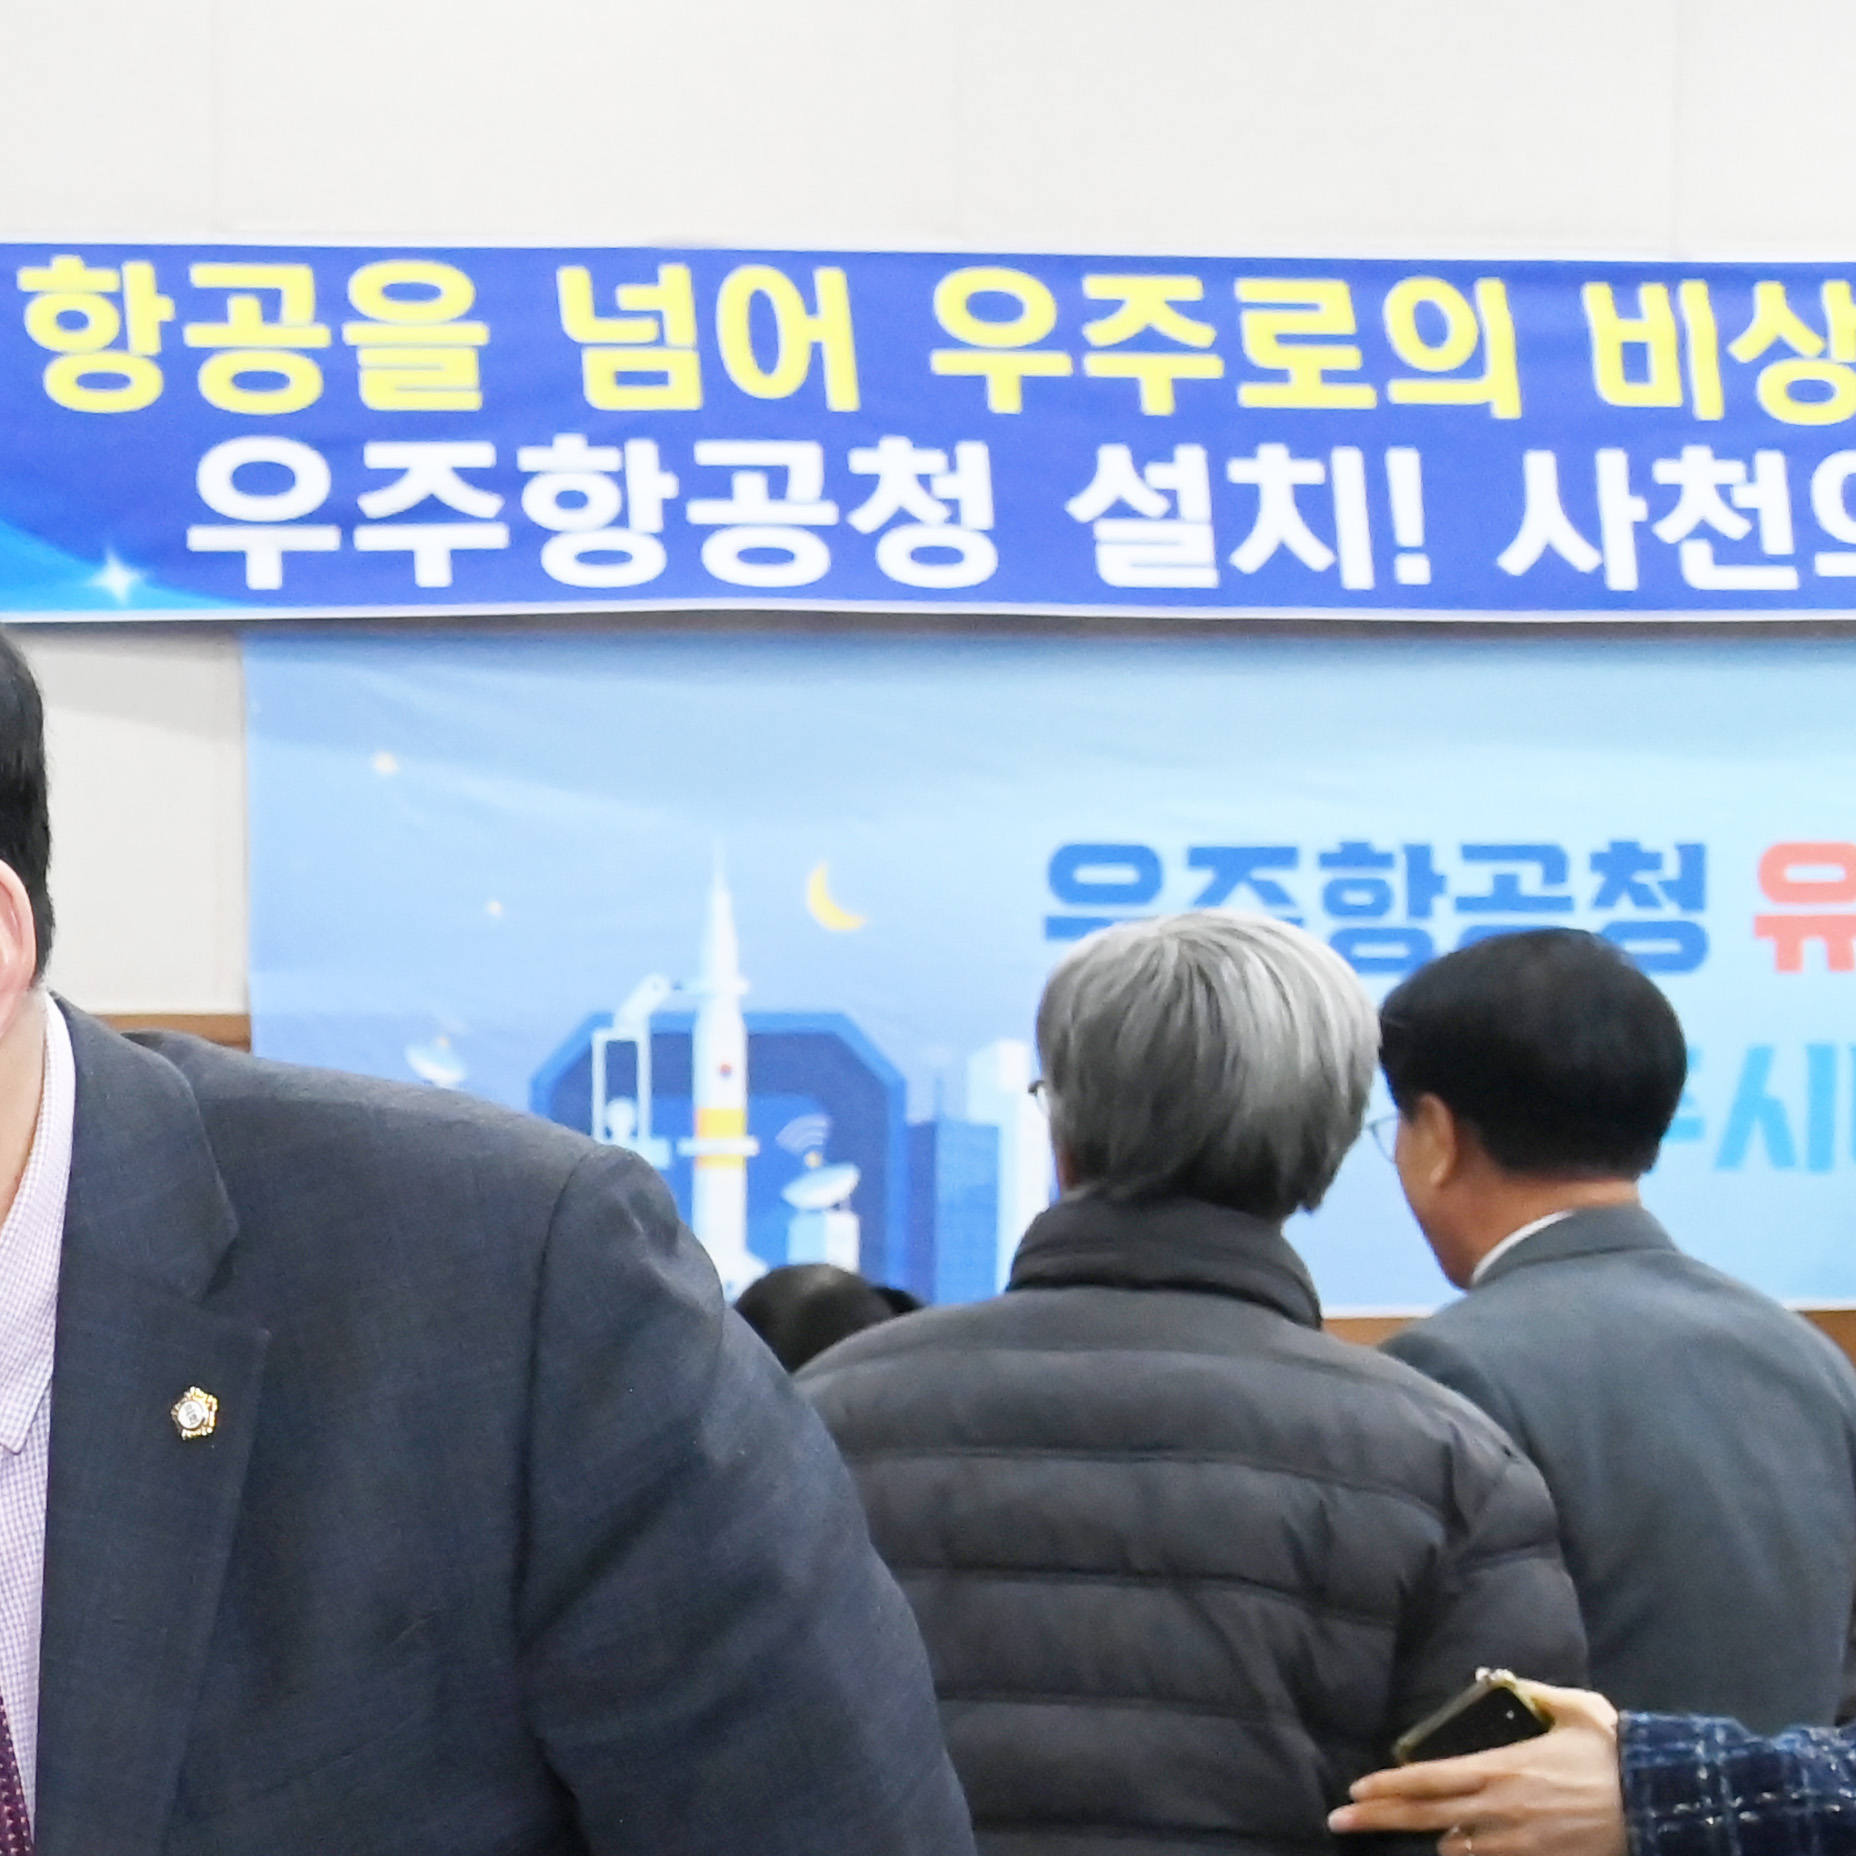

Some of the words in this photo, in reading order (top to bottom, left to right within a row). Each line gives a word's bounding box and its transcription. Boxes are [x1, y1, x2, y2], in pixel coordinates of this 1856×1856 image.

[18, 256, 490, 415] 항공을
[559, 263, 861, 412] 넘어
[931, 266, 1524, 420] 우주로의
[1583, 279, 1856, 426] 비상
[186, 432, 1001, 592] 우주항공청
[1065, 442, 1433, 592] 설치!
